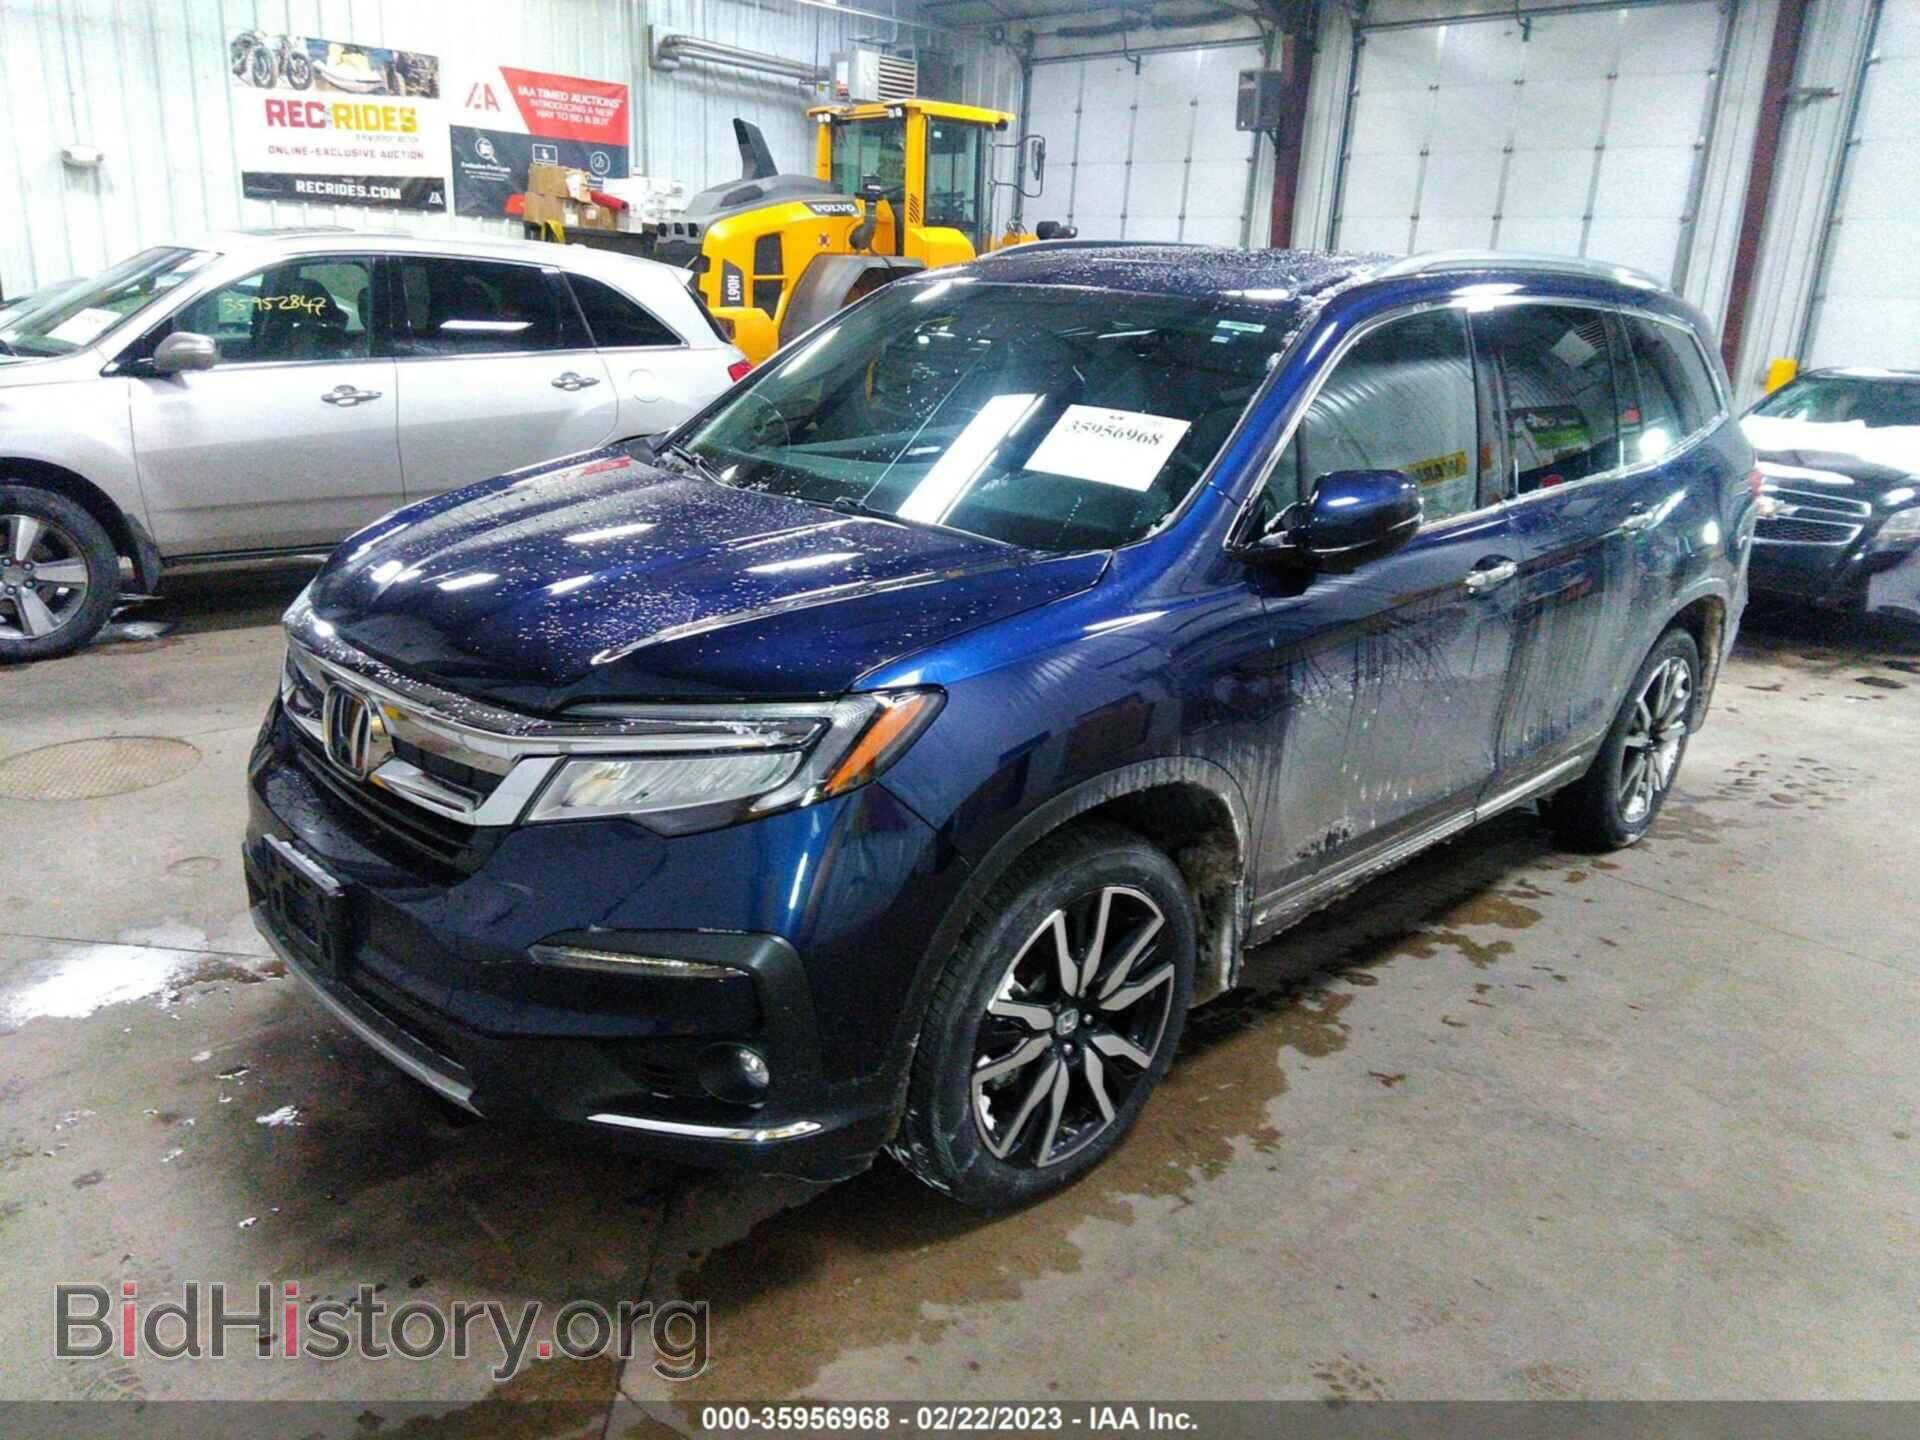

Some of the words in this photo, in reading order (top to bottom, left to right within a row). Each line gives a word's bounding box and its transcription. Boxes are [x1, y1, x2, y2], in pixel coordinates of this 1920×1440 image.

[537, 88, 568, 102] TIMED
[571, 93, 621, 109] AUCTIONS
[332, 103, 418, 132] RIDES
[380, 151, 424, 160] AUCTION
[296, 179, 401, 200] RECRIDES.COM
[811, 203, 856, 213] VOLVO
[727, 275, 740, 301] L90H
[1071, 419, 1163, 446] 35956968
